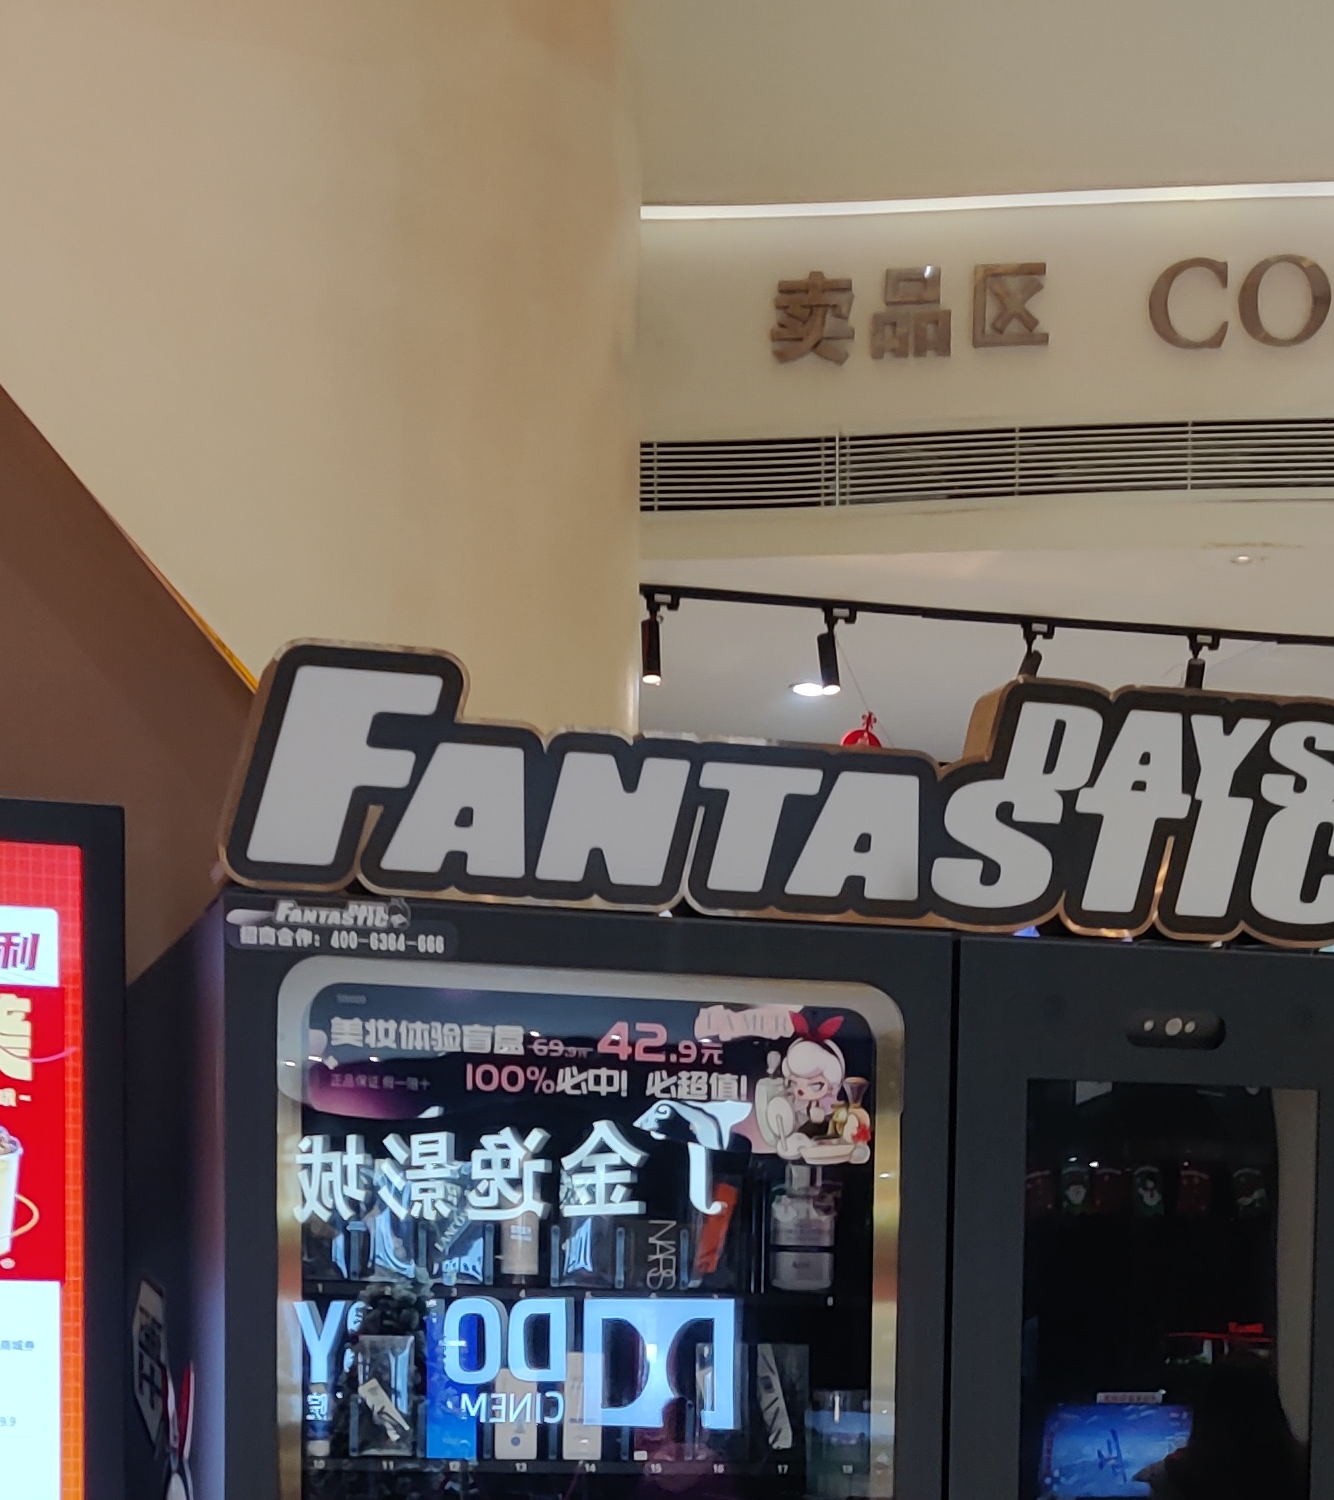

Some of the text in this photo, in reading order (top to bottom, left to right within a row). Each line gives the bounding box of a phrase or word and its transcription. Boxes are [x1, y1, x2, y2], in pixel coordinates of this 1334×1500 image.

[769, 262, 1049, 366] 卖品区
[331, 1016, 525, 1055] 美妆体验盲盒
[646, 1220, 677, 1290] NARS
